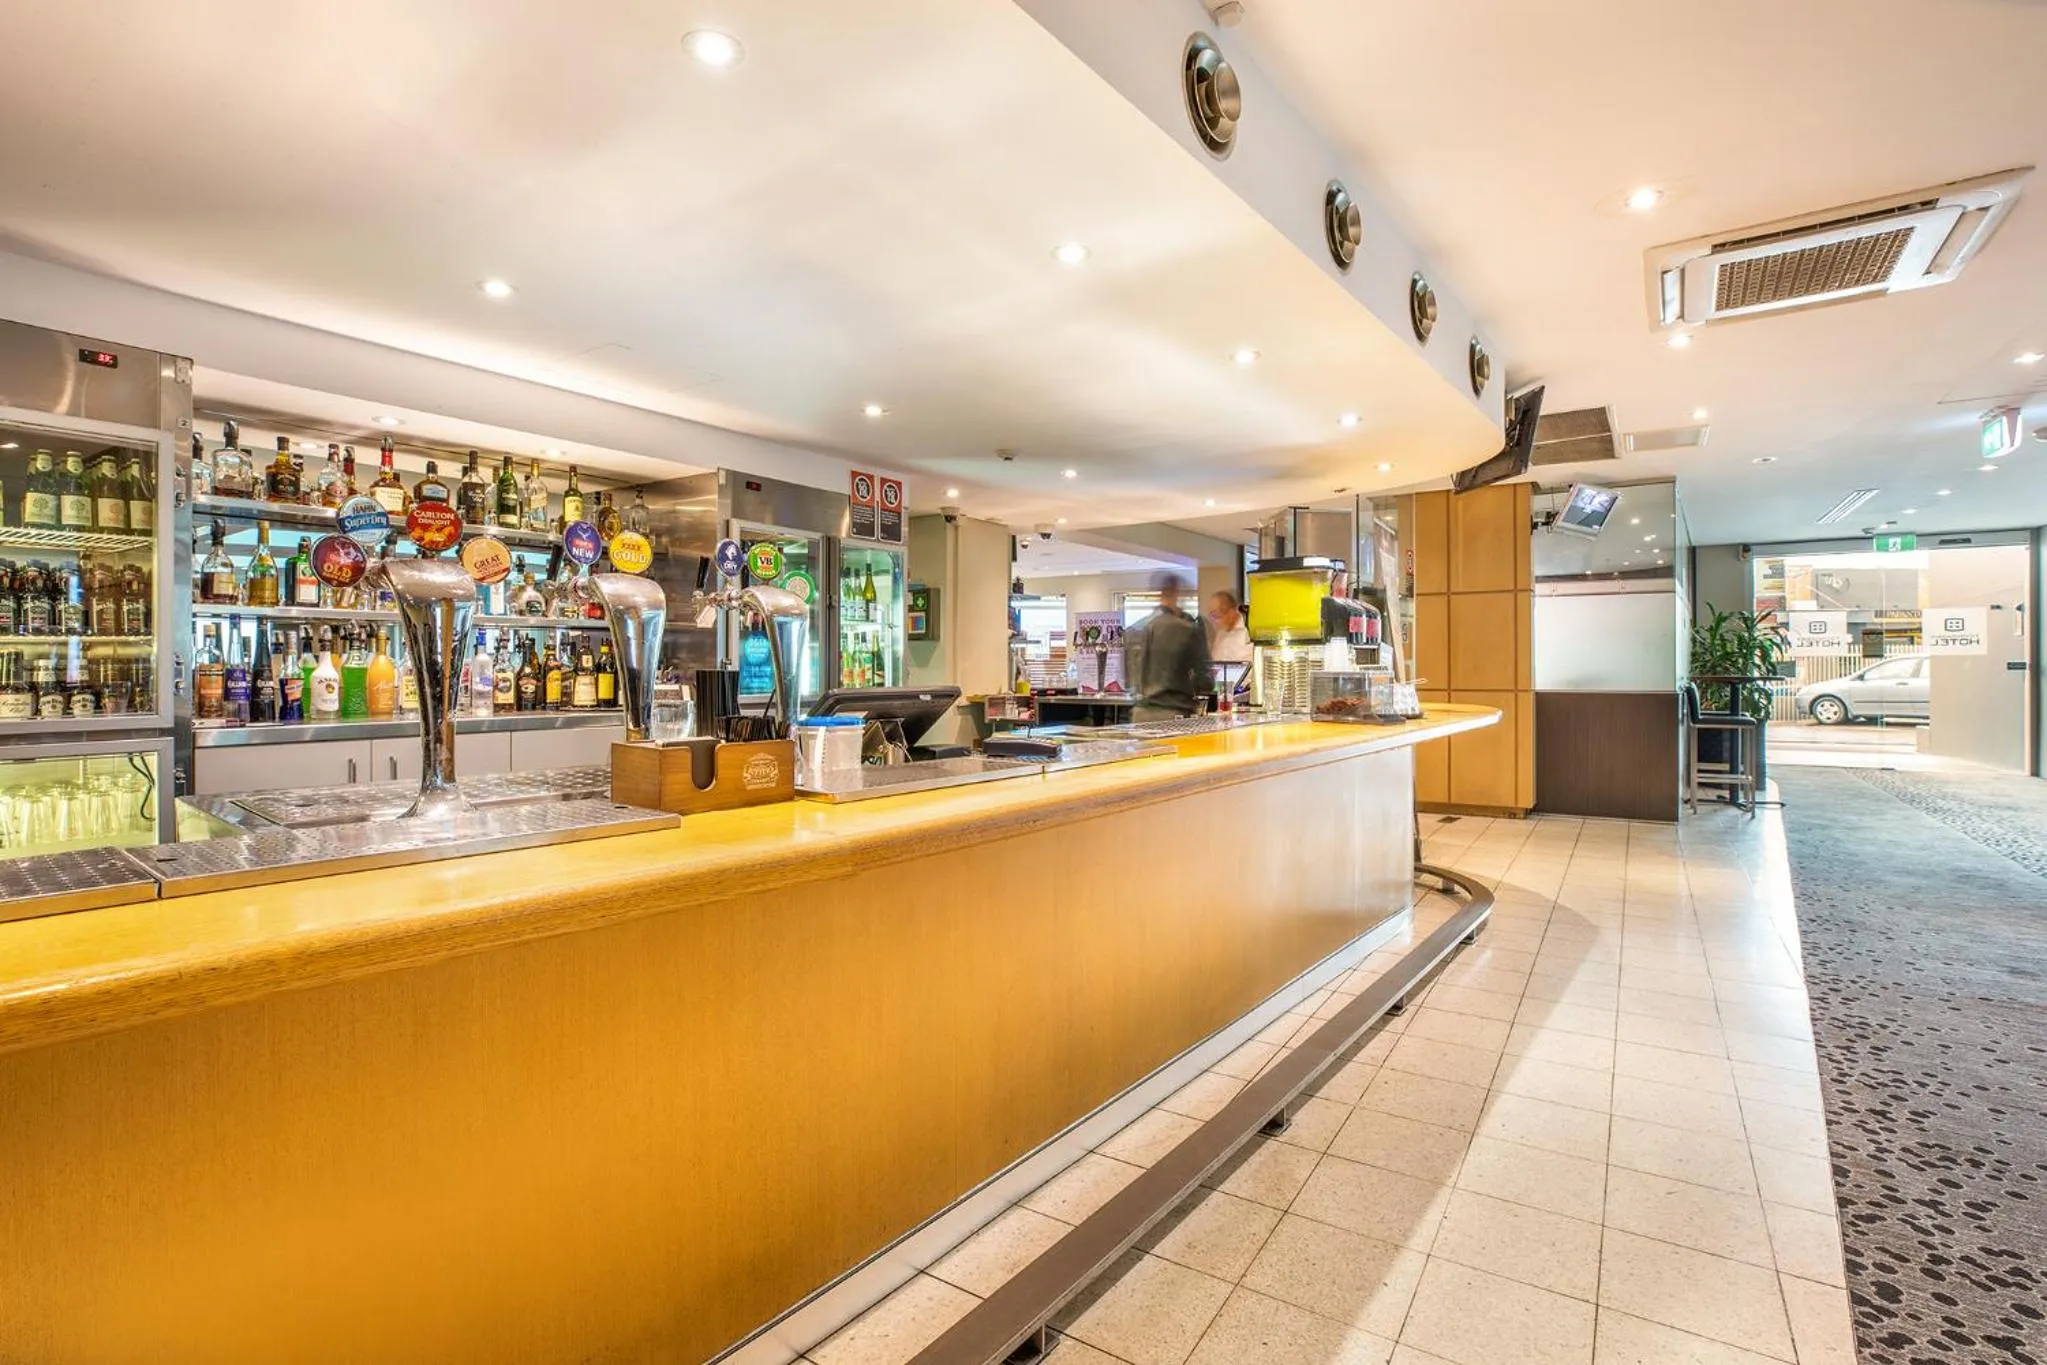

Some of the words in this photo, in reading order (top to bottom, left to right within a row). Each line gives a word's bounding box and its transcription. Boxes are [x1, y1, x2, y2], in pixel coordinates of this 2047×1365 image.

[413, 510, 455, 521] CARLTON
[571, 547, 595, 559] NEW
[613, 550, 647, 563] GOLD
[474, 554, 501, 570] GREAT
[759, 556, 773, 566] VB
[323, 562, 352, 578] OLD
